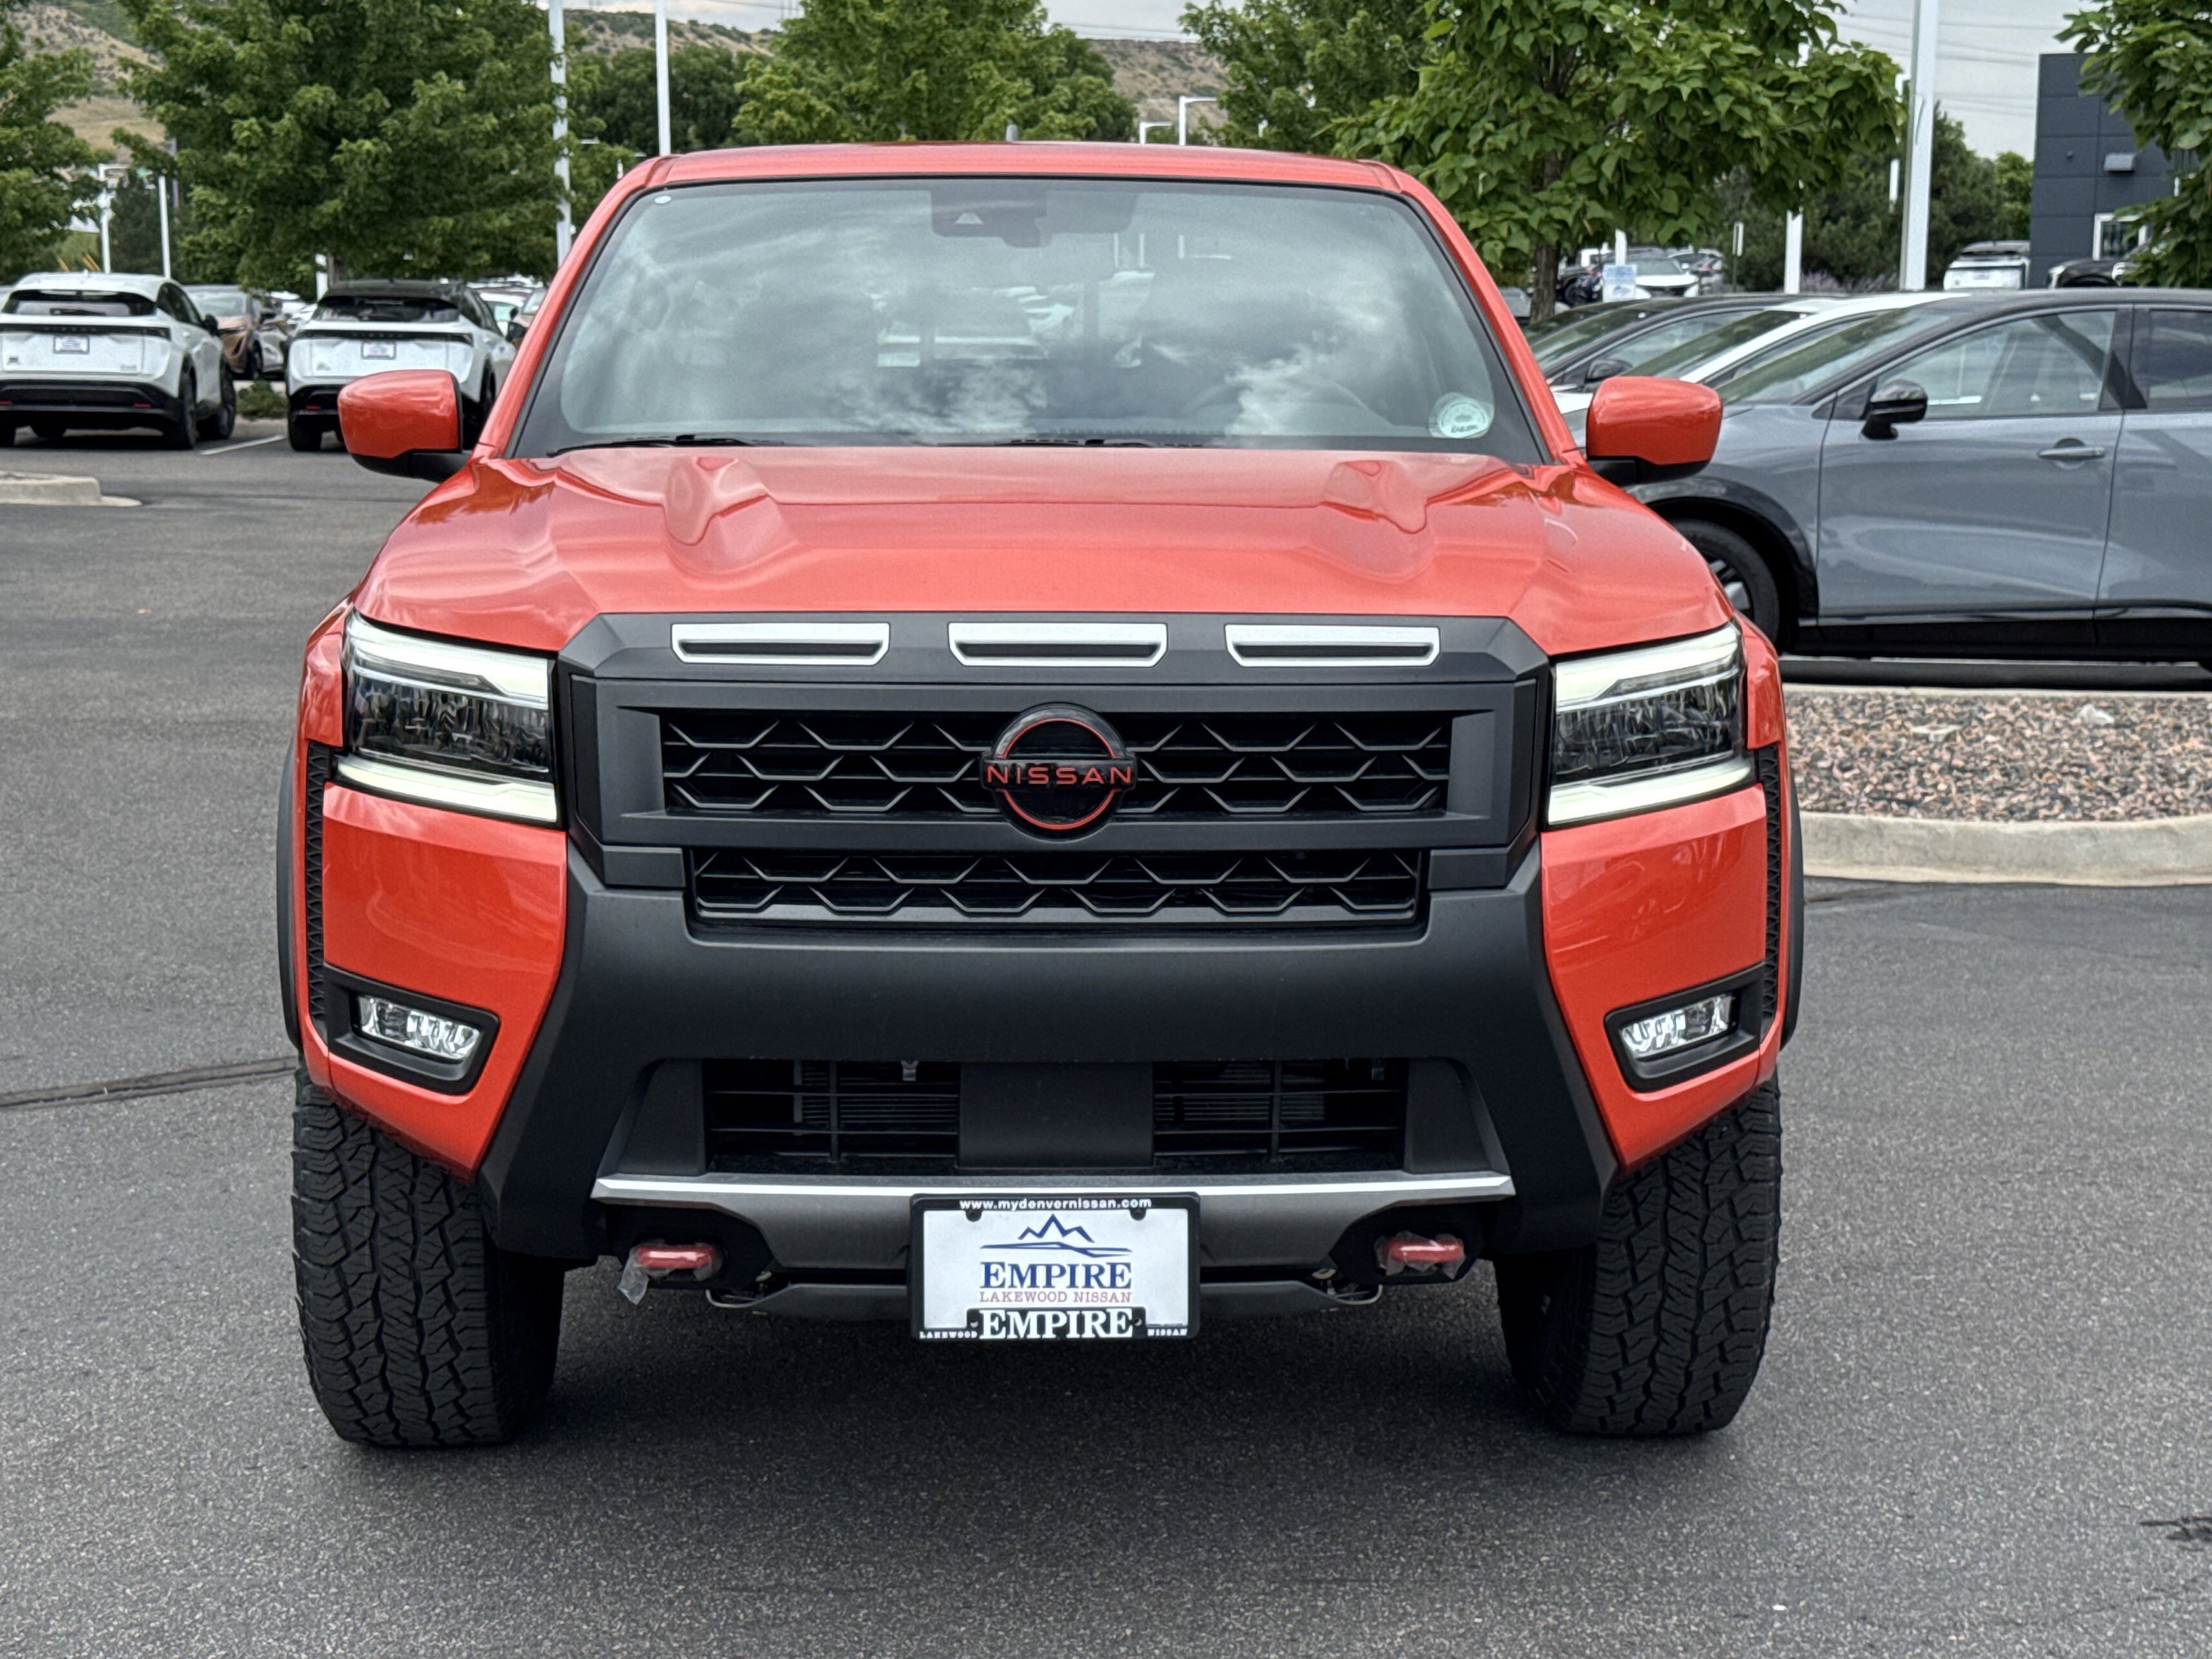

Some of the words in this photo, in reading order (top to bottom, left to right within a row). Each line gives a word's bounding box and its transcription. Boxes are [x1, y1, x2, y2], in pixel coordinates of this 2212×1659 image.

[988, 765, 1132, 785] NISSAN
[960, 1198, 1152, 1211] www.mydenvernissan.com
[980, 1261, 1132, 1289] EMPIRE
[980, 1291, 1067, 1302] LAKEWOOD
[1073, 1291, 1132, 1303] NISSAN
[979, 1308, 1133, 1339] EMPIRE
